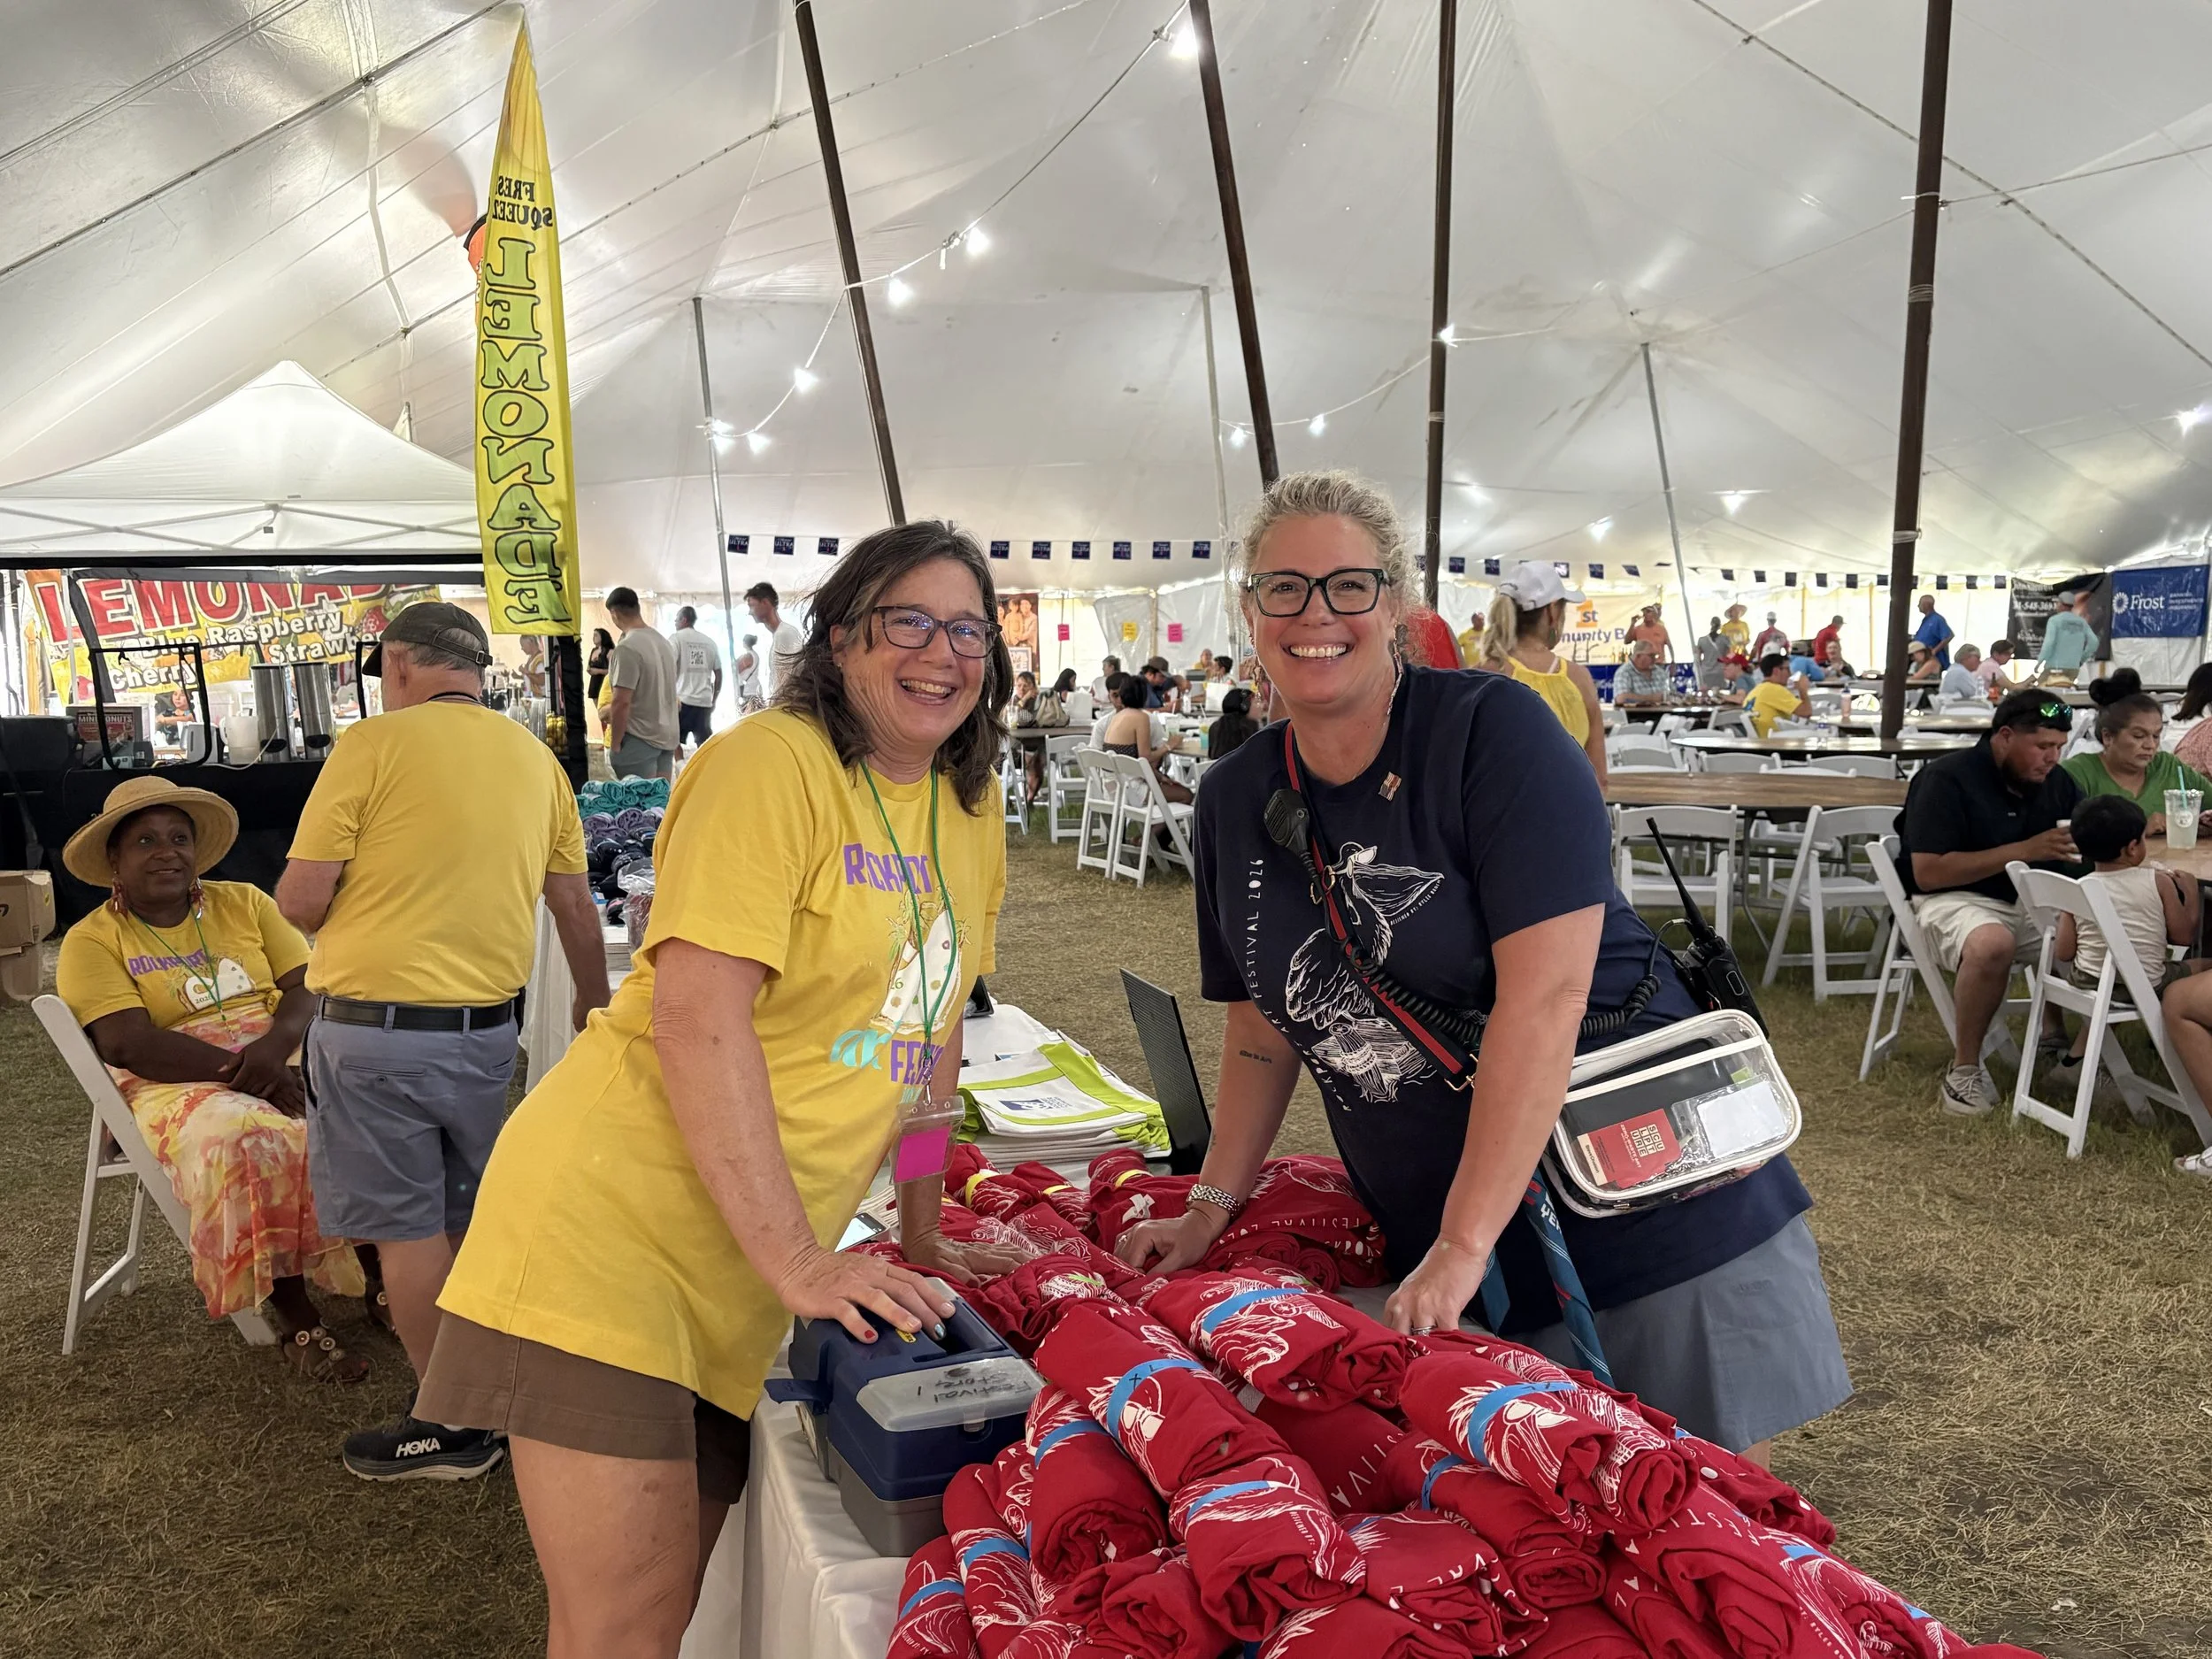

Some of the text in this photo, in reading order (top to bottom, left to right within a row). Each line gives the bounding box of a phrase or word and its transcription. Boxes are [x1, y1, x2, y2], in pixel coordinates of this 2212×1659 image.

[2130, 594, 2165, 610] Frost
[206, 611, 343, 646] Raspberry
[110, 664, 197, 690] Cherry
[104, 715, 133, 724] ONUTS
[1248, 859, 1264, 900] 2026
[1246, 910, 1263, 999] FESTIVAL
[1263, 1009, 1290, 1033] ART
[395, 1437, 442, 1458] HOKA
